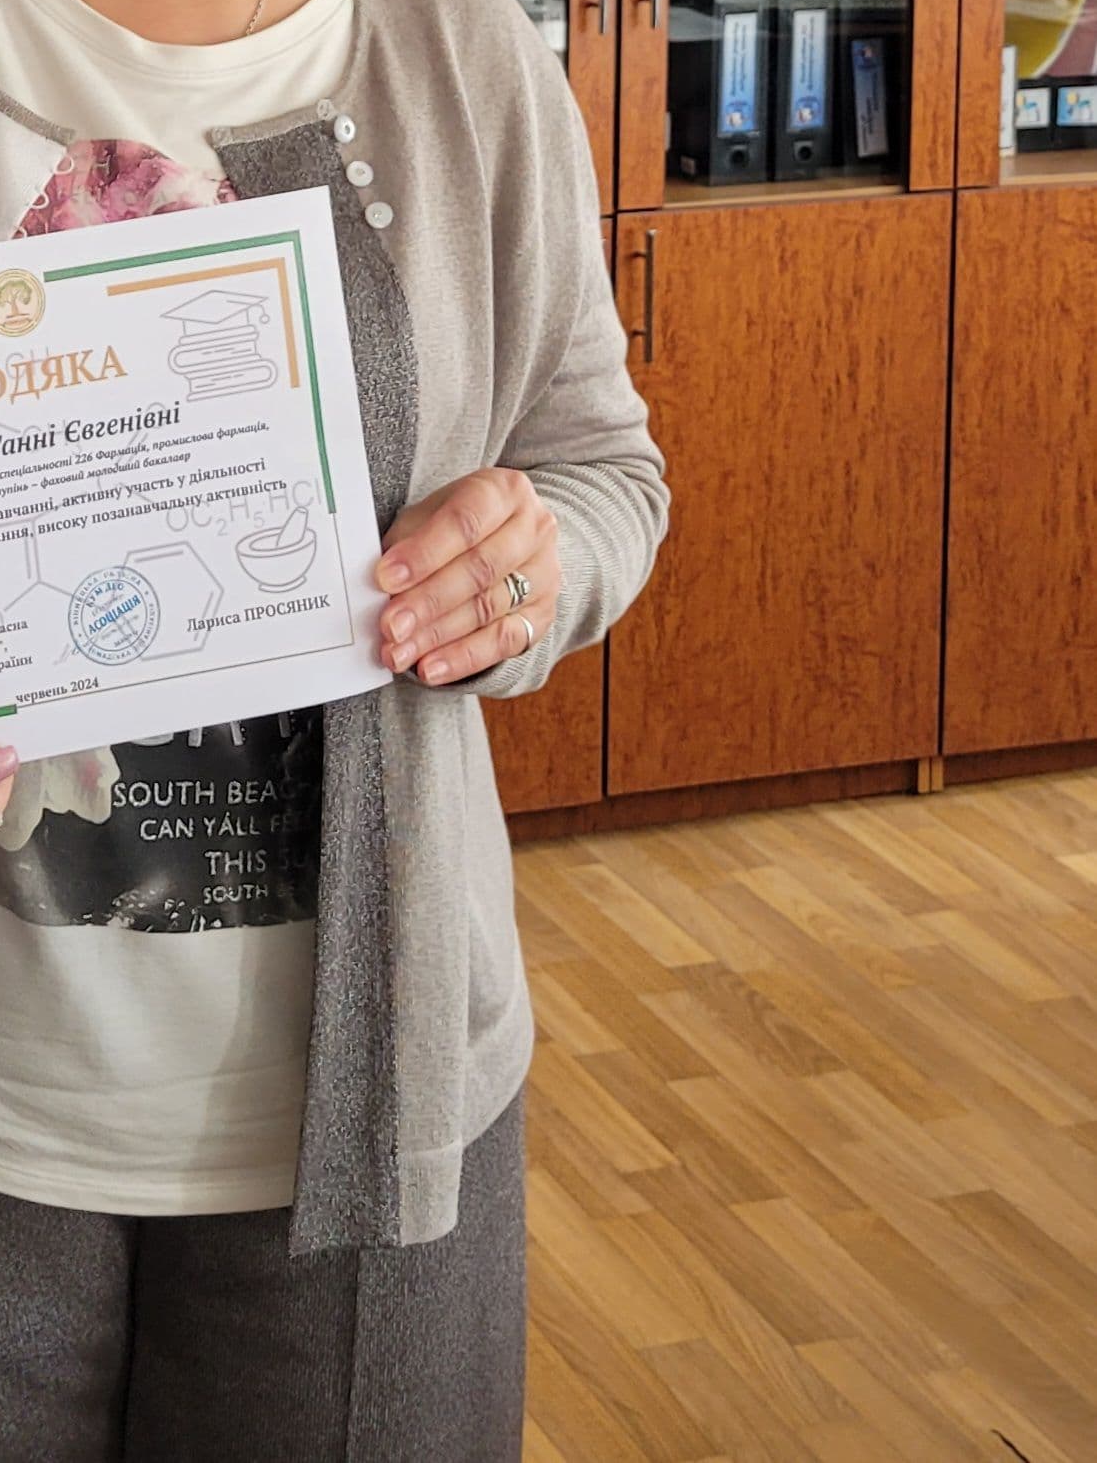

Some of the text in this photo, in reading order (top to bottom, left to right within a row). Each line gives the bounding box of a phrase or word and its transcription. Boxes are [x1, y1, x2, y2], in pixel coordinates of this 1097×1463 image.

[63, 399, 181, 444] Євгенівні
[73, 451, 95, 466] 226
[61, 486, 124, 509] активну
[123, 477, 176, 500] участь
[175, 473, 187, 490] у
[187, 456, 267, 487] діяльності
[36, 514, 89, 536] високу
[90, 493, 204, 525] позанавчальну
[205, 478, 288, 504] активність
[87, 594, 142, 635] АСОЦІАЦІЯ
[186, 593, 332, 633] Лариса ПРОСЯНИК
[14, 675, 100, 704] червень 2024
[112, 780, 215, 809] SOUTH
[139, 817, 194, 841] CAN
[204, 849, 267, 877] THIS
[203, 884, 269, 907] SOUTH
